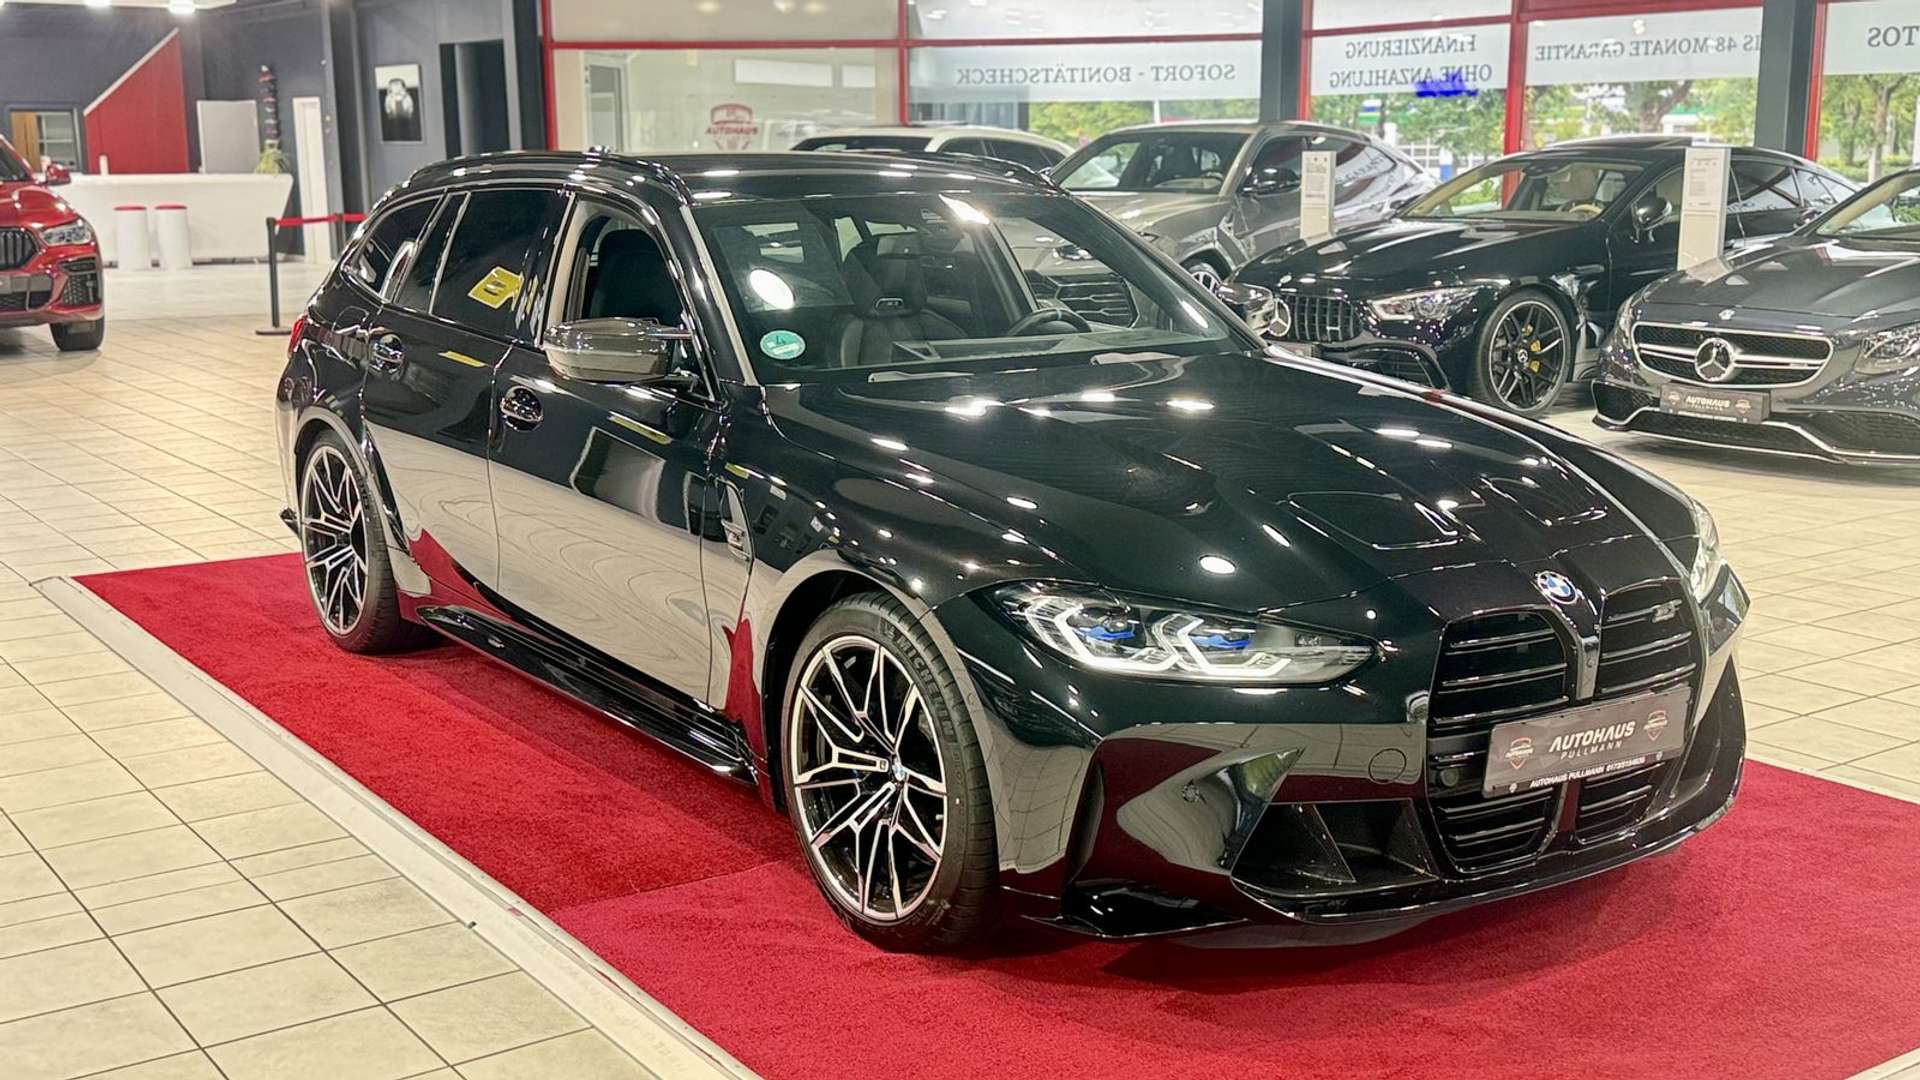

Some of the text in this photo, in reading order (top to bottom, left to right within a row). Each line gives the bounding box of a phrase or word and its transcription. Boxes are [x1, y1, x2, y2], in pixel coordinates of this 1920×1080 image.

[1686, 395, 1730, 408] AUTOHAUS
[895, 634, 957, 742] MICHELIN
[1549, 722, 1636, 752] AUTOHAUS
[1560, 740, 1623, 760] PULLMANN
[1529, 773, 1568, 788] AUTOHAUS
